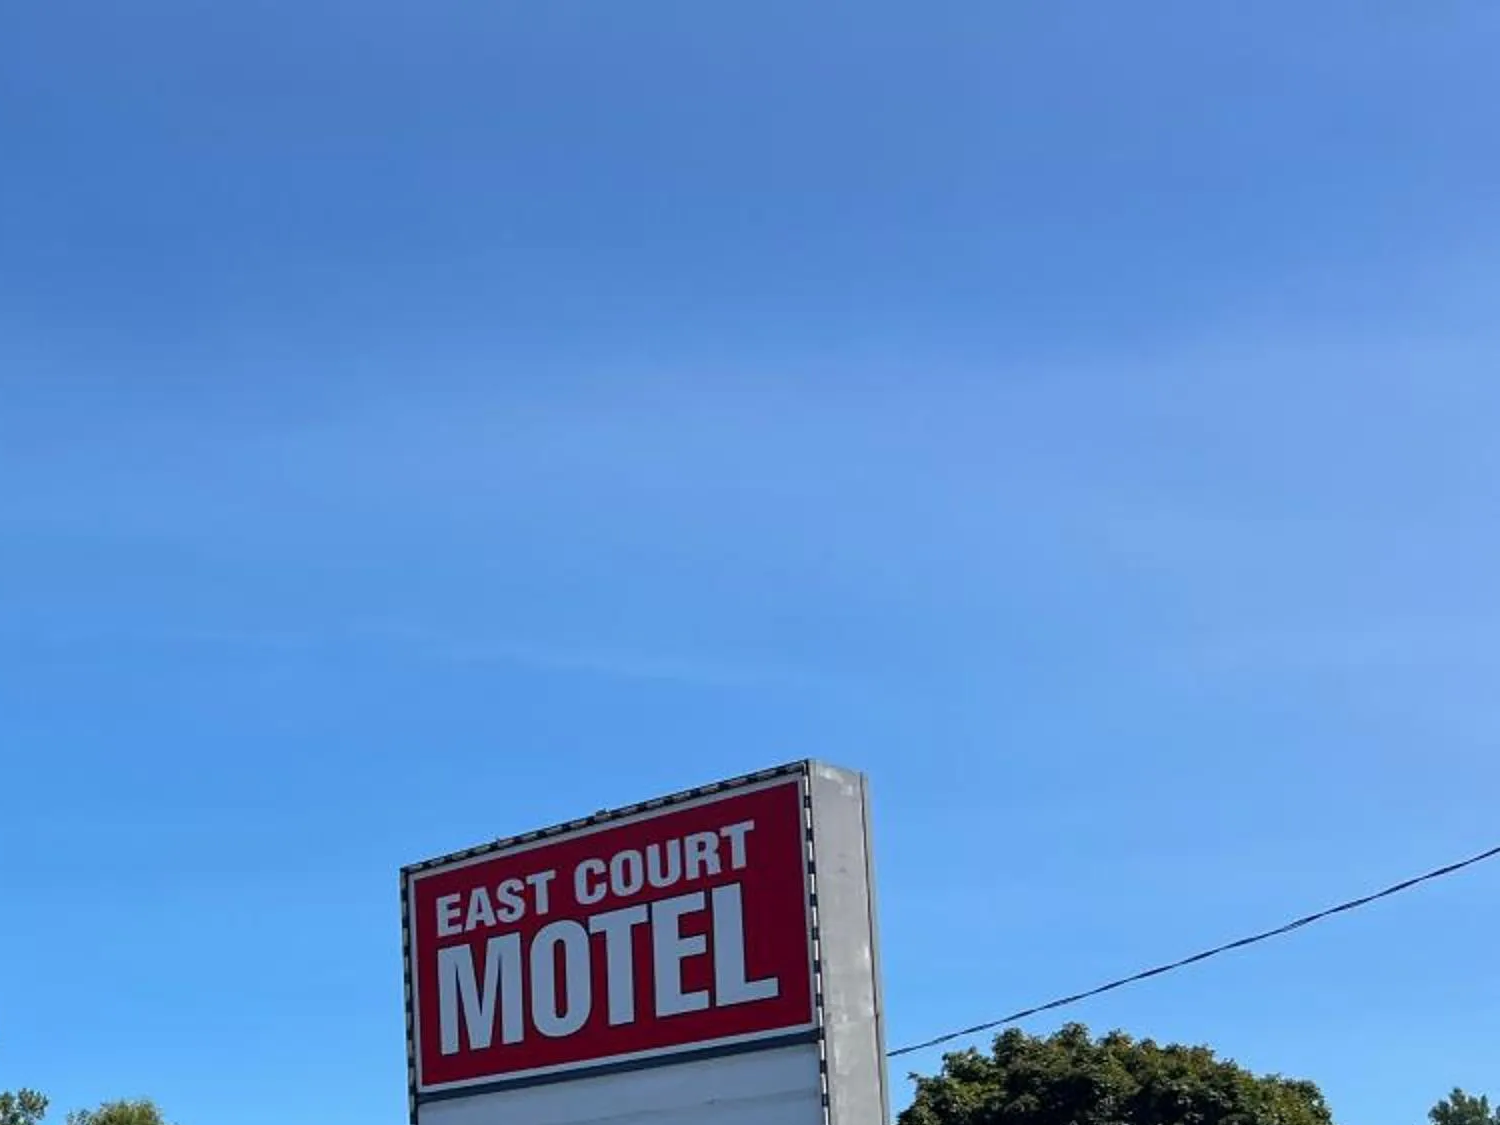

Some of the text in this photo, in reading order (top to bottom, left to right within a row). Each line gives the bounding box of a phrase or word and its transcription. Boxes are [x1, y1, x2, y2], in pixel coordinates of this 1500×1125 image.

[435, 820, 755, 938] EAST COURT
[436, 882, 779, 1056] MOTEL
